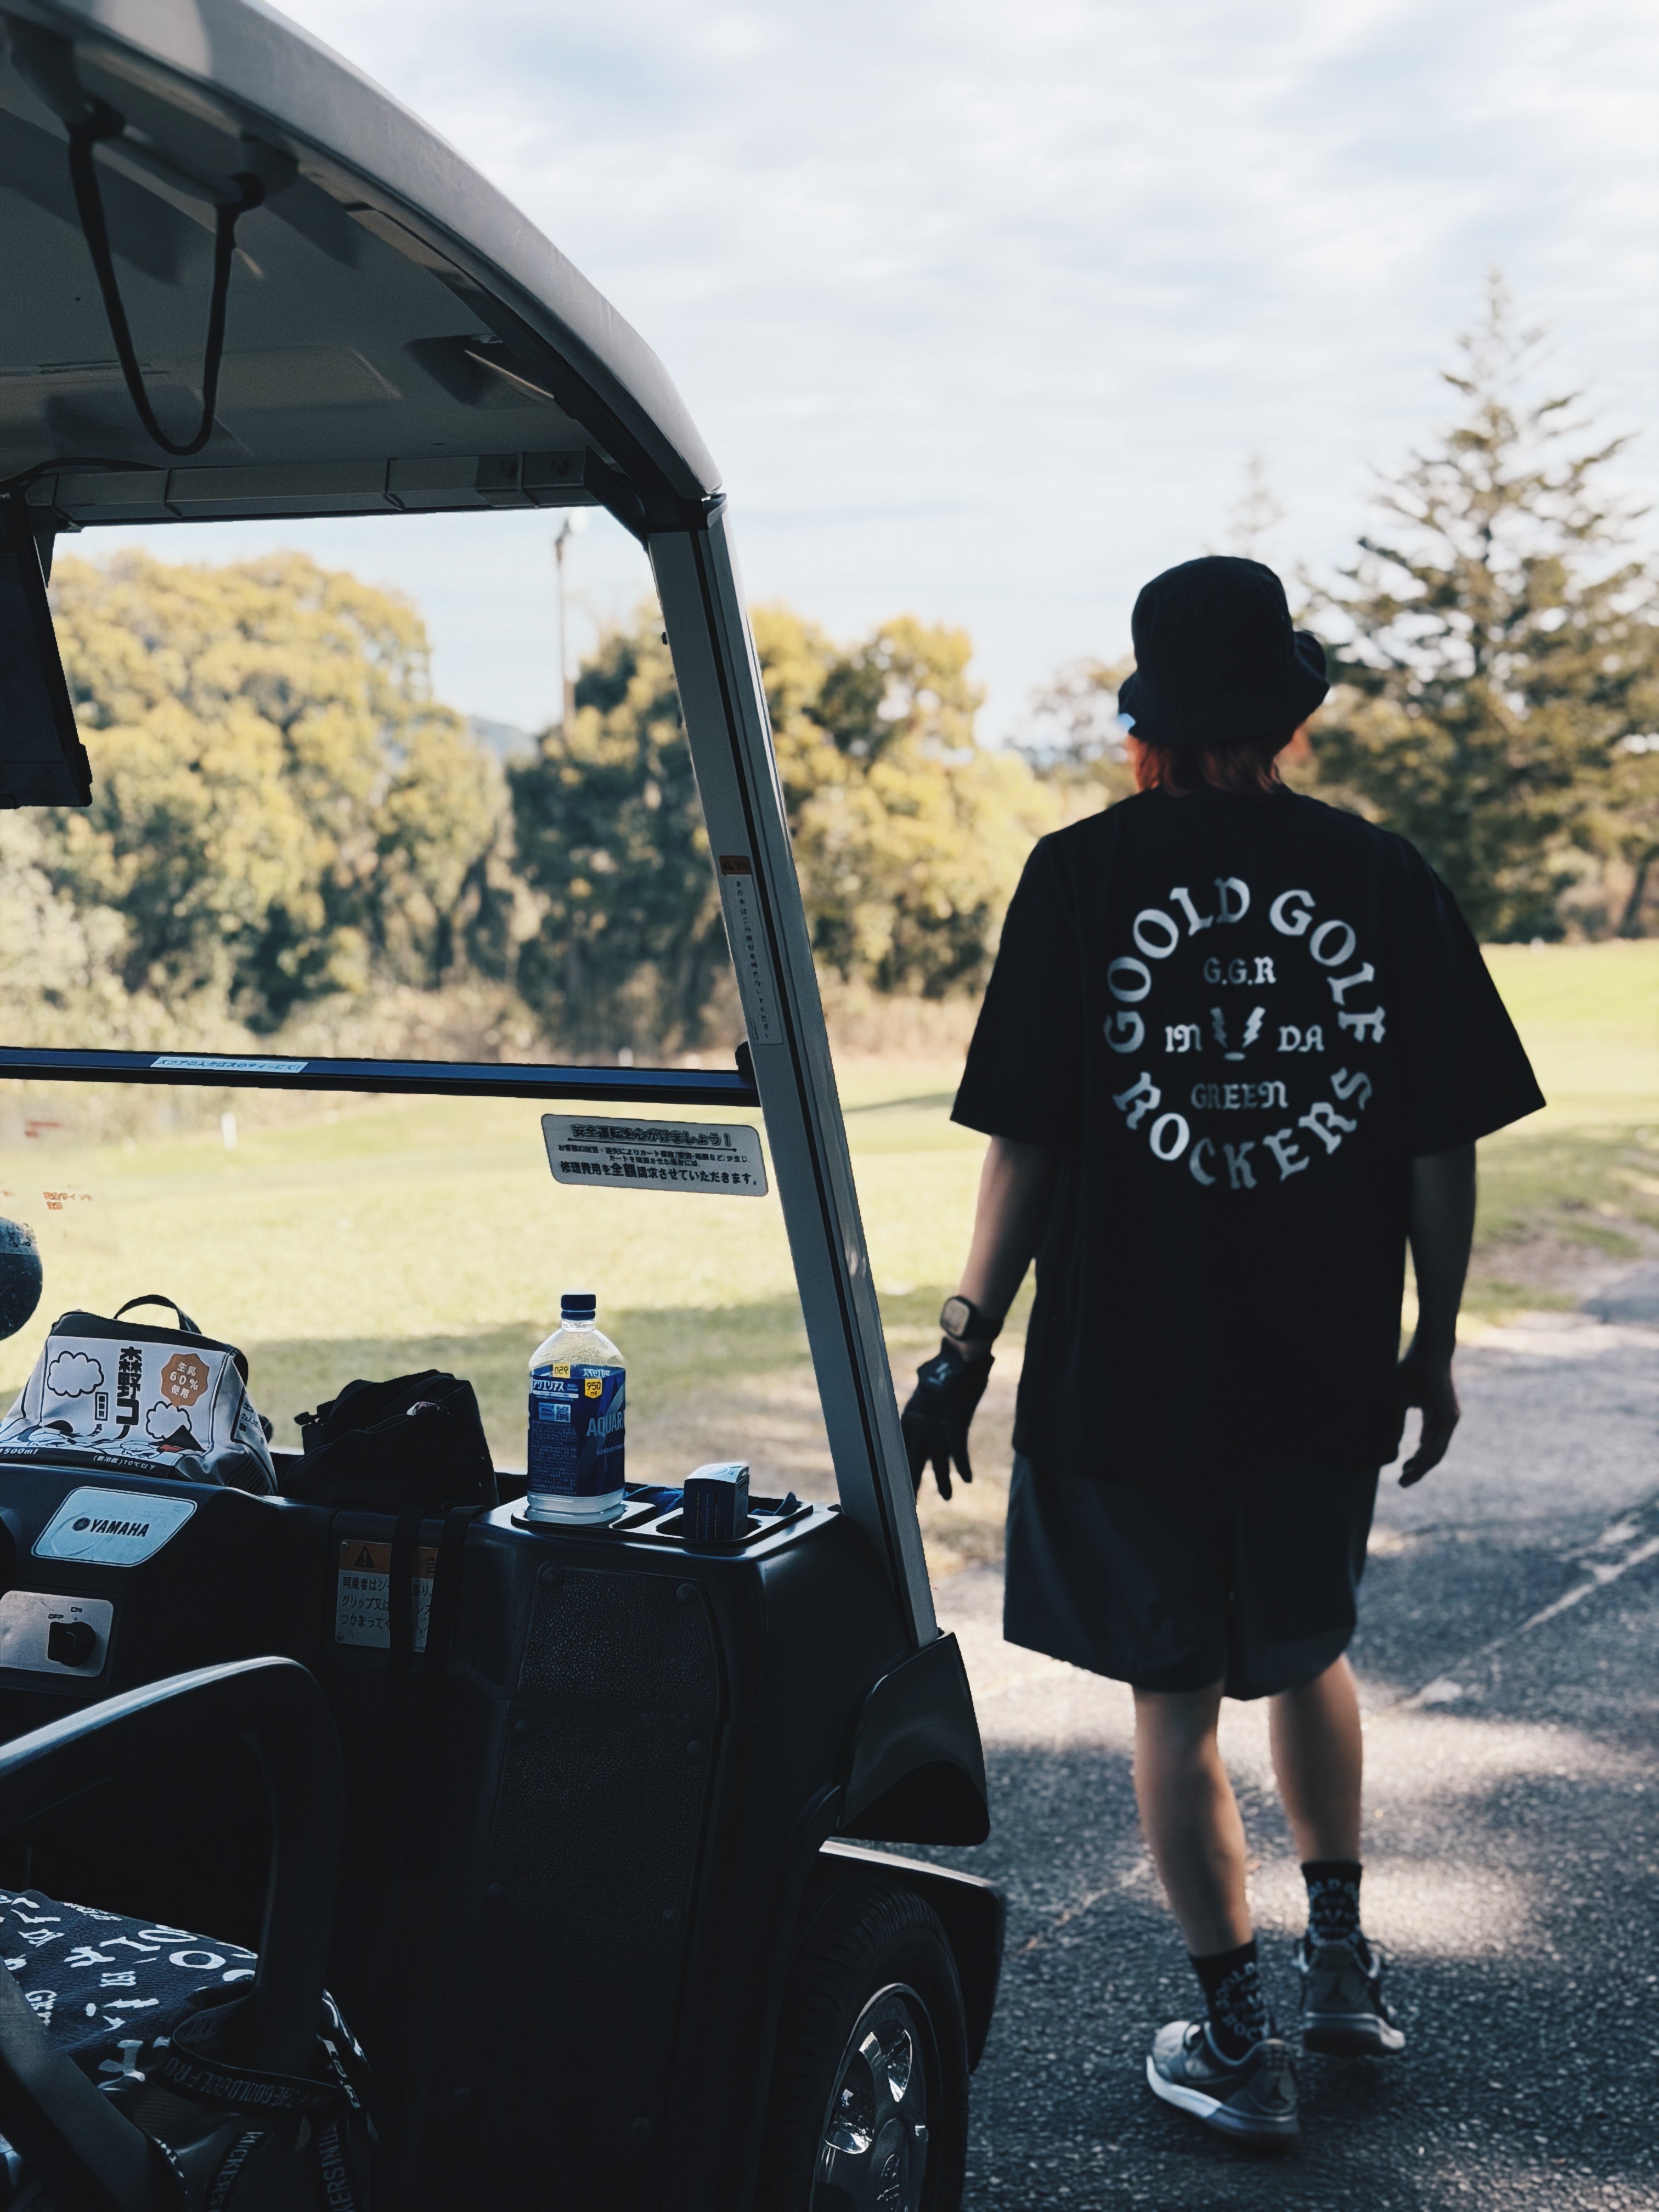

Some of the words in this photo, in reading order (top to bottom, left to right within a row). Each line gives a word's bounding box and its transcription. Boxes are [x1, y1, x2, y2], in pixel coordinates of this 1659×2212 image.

[1103, 876, 1250, 1054] GOOLD
[1269, 889, 1386, 1043] GOLF
[1204, 956, 1277, 985] G.G.R
[1164, 1024, 1203, 1053] IN
[1277, 1024, 1325, 1052] DA
[1191, 1080, 1289, 1110] GREEN
[1112, 1067, 1373, 1189] ROCKERS
[586, 1381, 601, 1391] 950
[90, 1519, 149, 1537] YAMAHA
